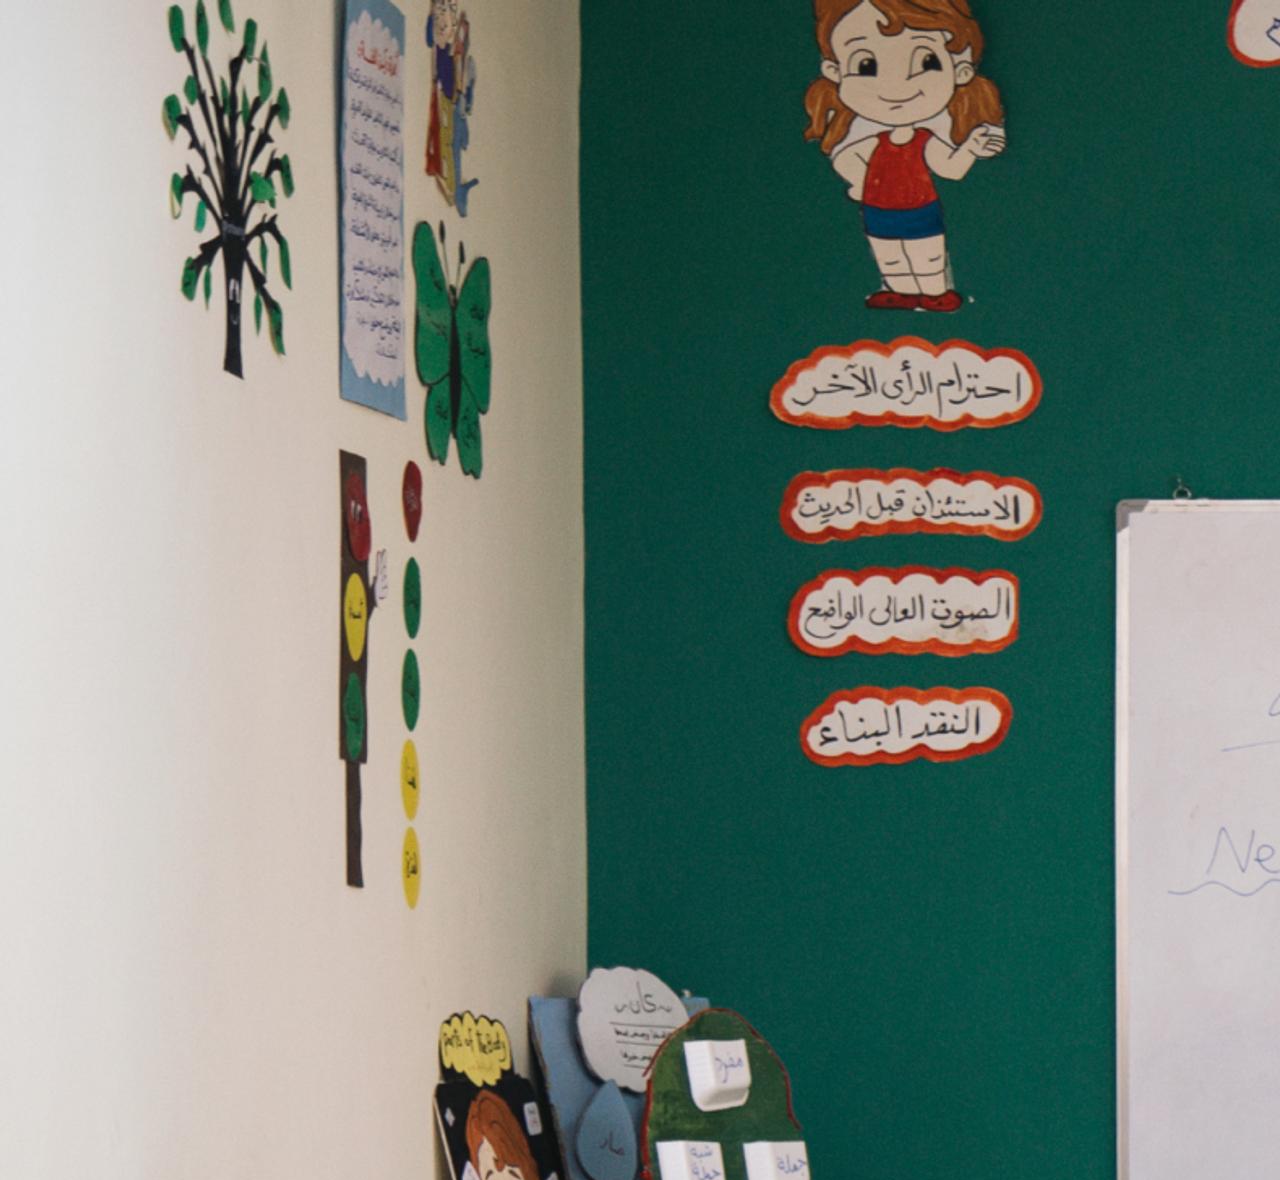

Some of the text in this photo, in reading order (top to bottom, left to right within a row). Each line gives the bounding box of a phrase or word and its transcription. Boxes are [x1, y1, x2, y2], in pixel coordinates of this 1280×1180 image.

[791, 362, 879, 407] الآخر
[936, 361, 1022, 418] احترام
[797, 485, 862, 525] الحديث
[866, 488, 906, 521] قبل
[803, 589, 866, 640] الواضح
[930, 585, 1012, 630] الصوت
[817, 703, 982, 748] النقد البناء
